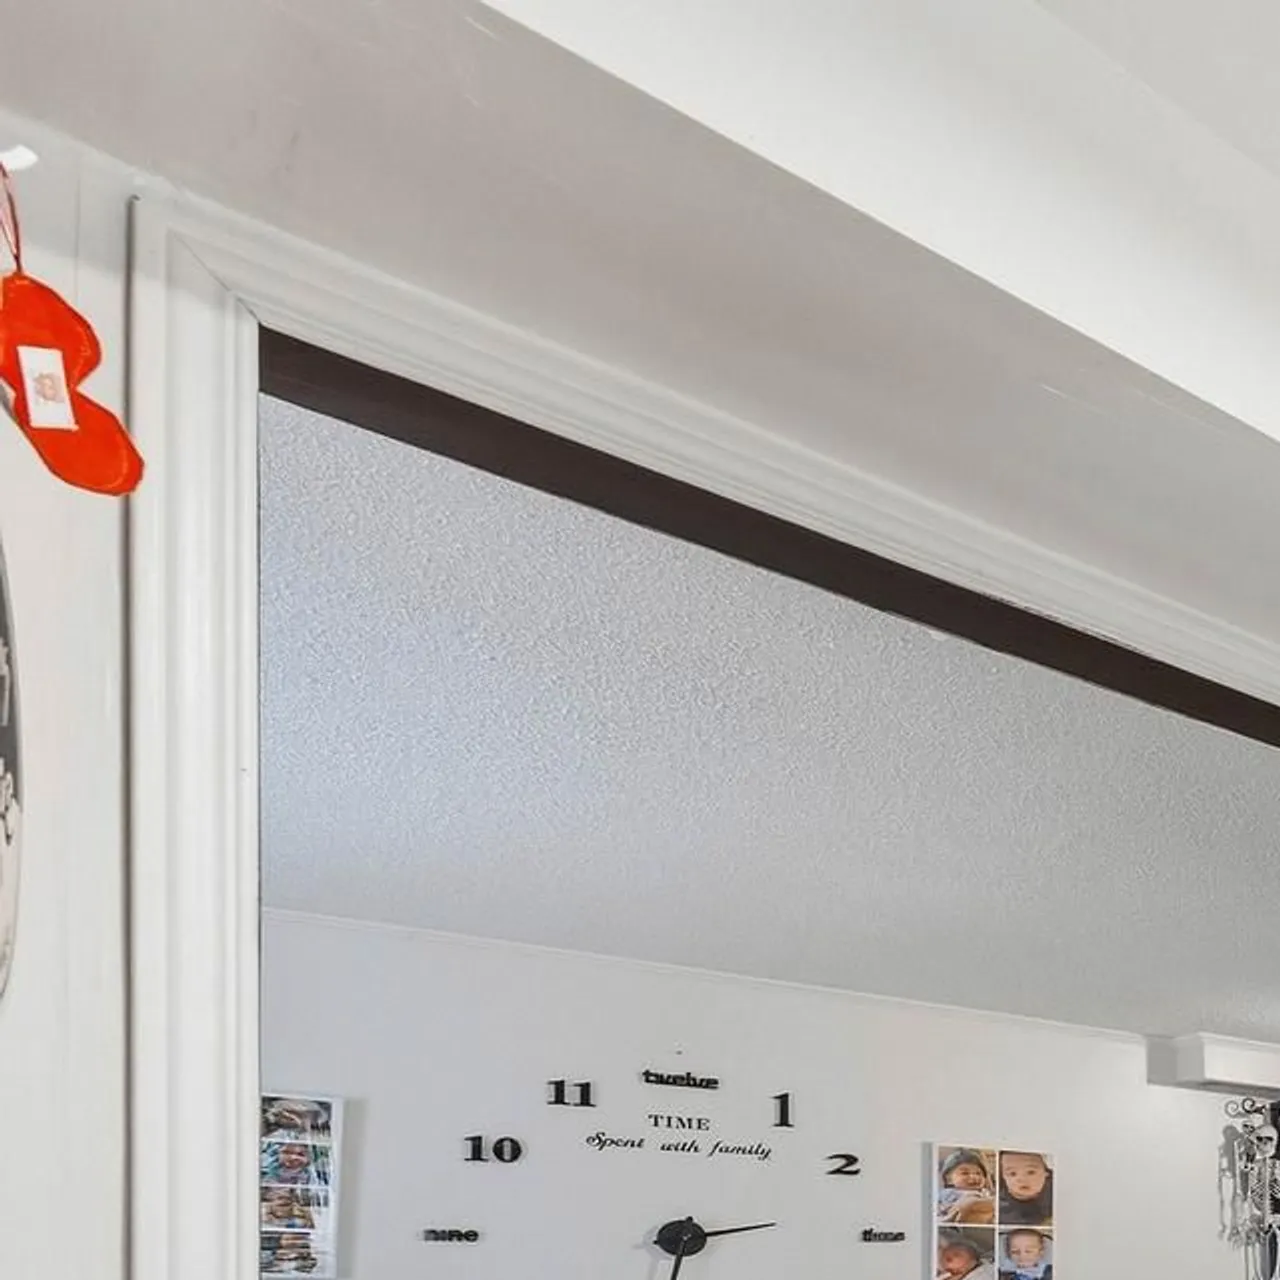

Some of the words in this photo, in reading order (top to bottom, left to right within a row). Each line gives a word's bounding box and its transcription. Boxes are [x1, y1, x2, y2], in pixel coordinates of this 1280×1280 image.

[642, 1069, 719, 1089] twelve
[547, 1080, 596, 1107] 11
[648, 1114, 710, 1131] TIME
[771, 1092, 794, 1127] 1
[464, 1135, 522, 1163] 10
[586, 1132, 646, 1151] Spent
[660, 1140, 701, 1153] with
[707, 1140, 772, 1161] family
[824, 1154, 861, 1176] 2
